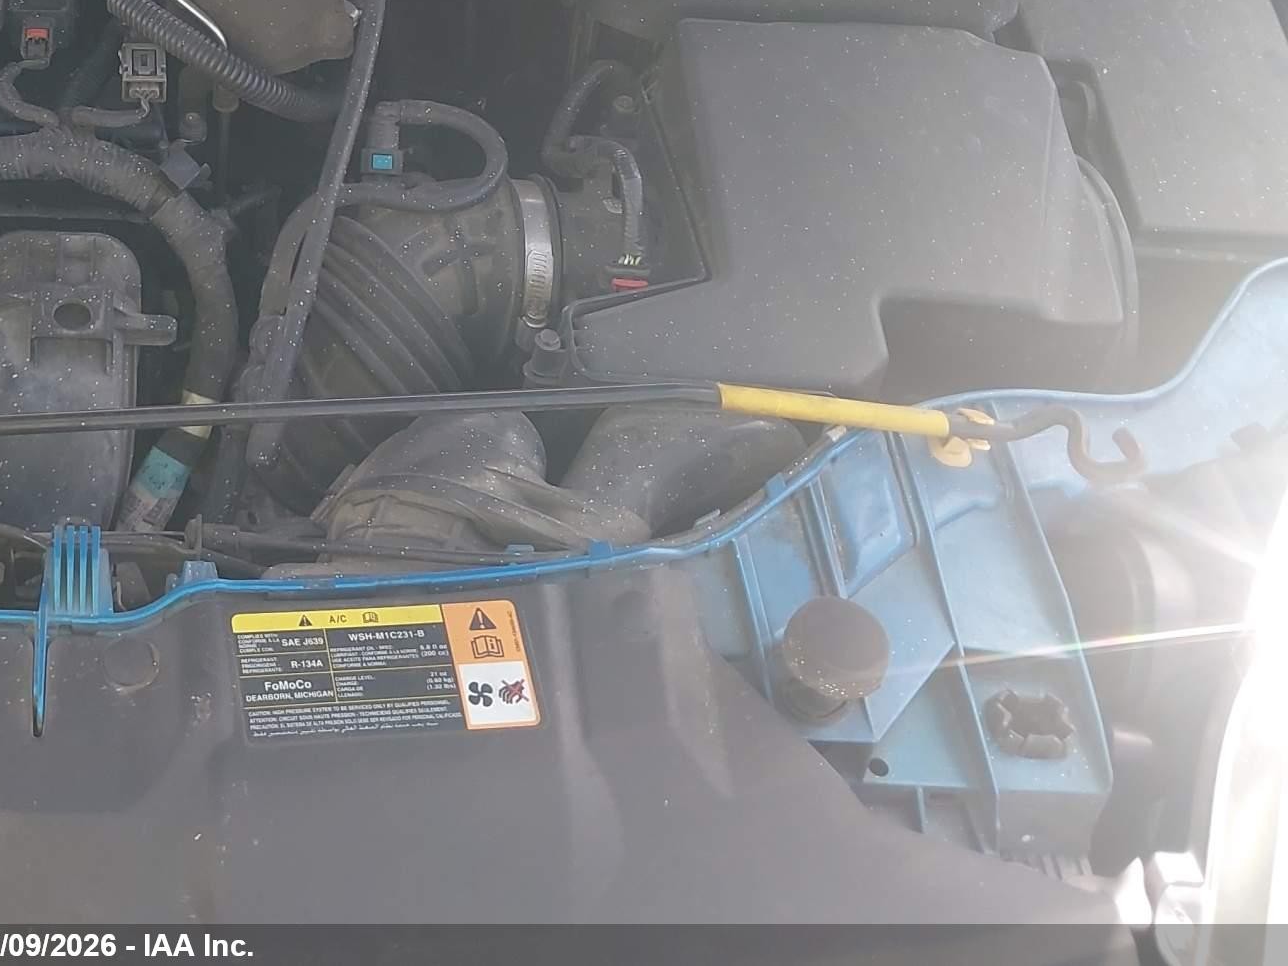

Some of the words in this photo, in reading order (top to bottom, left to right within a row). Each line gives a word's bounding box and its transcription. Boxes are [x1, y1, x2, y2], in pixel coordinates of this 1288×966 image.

[329, 615, 347, 624] A/C
[347, 629, 425, 642] WSH-M1C231-B
[281, 638, 301, 647] SAE
[303, 637, 324, 645] J639
[291, 660, 323, 669] R-134A
[264, 679, 312, 692] FoMoCo
[246, 693, 294, 703] DEARBORN,
[294, 690, 334, 700] MICHIGAN
